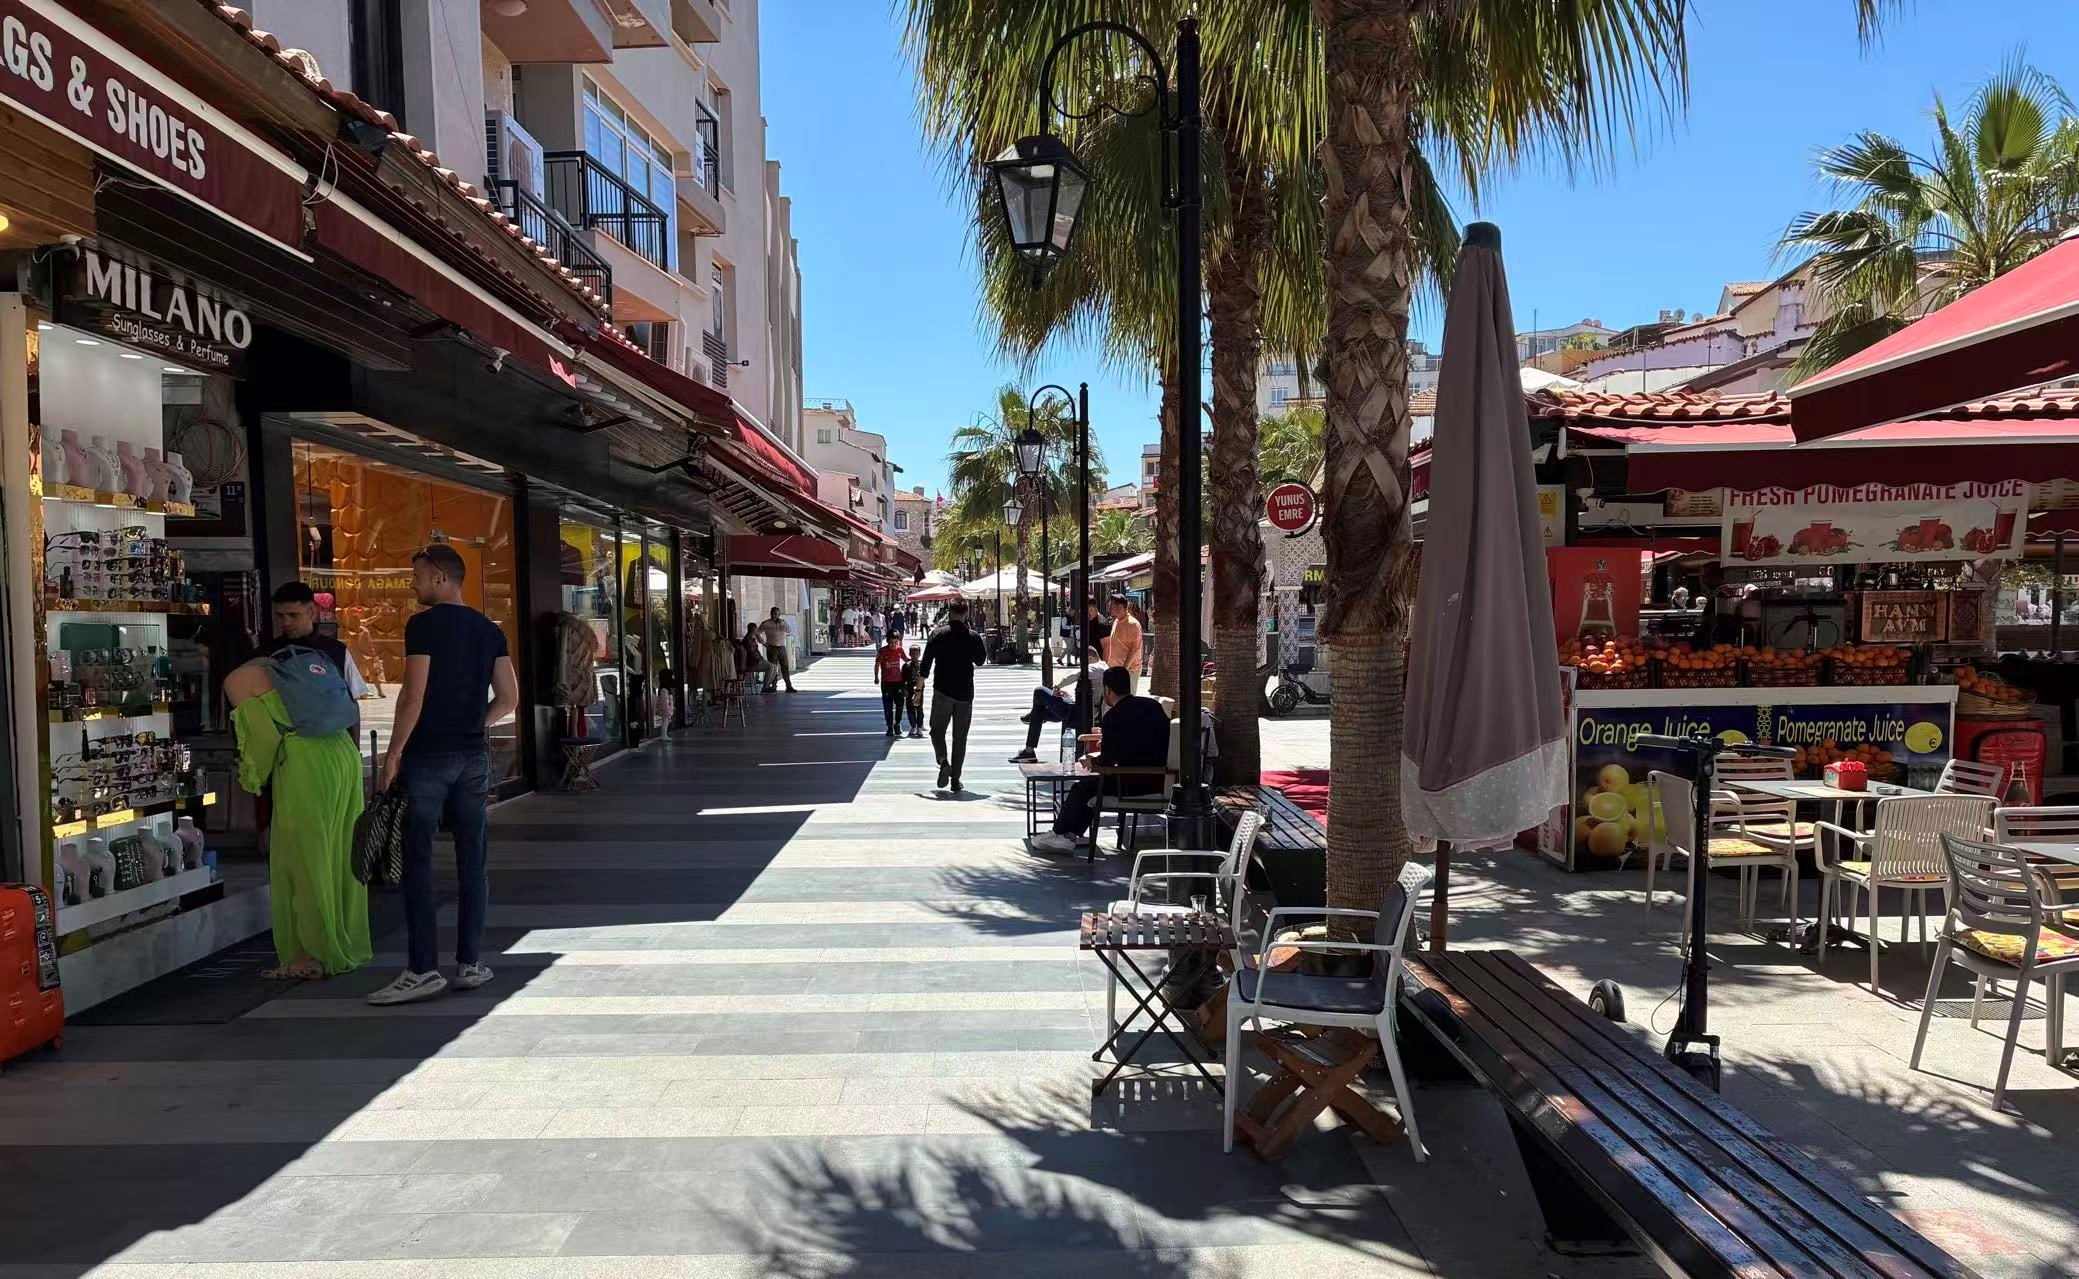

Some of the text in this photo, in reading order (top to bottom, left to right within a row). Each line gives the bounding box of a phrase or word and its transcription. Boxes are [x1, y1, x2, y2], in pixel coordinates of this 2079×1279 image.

[0, 16, 206, 180] GS & SHOES
[85, 251, 252, 348] MILANO
[112, 313, 229, 366] Sunglasses & Perfume
[1275, 493, 1305, 507] YUNUS
[1730, 487, 1795, 506] FRESH
[1803, 482, 1956, 505] POMEGRANATE
[1963, 479, 2023, 499] JUICE
[1278, 508, 1304, 521] EMRE
[1580, 714, 1711, 752] Orange Juice
[1778, 713, 1905, 746] Pomegranate Juice
